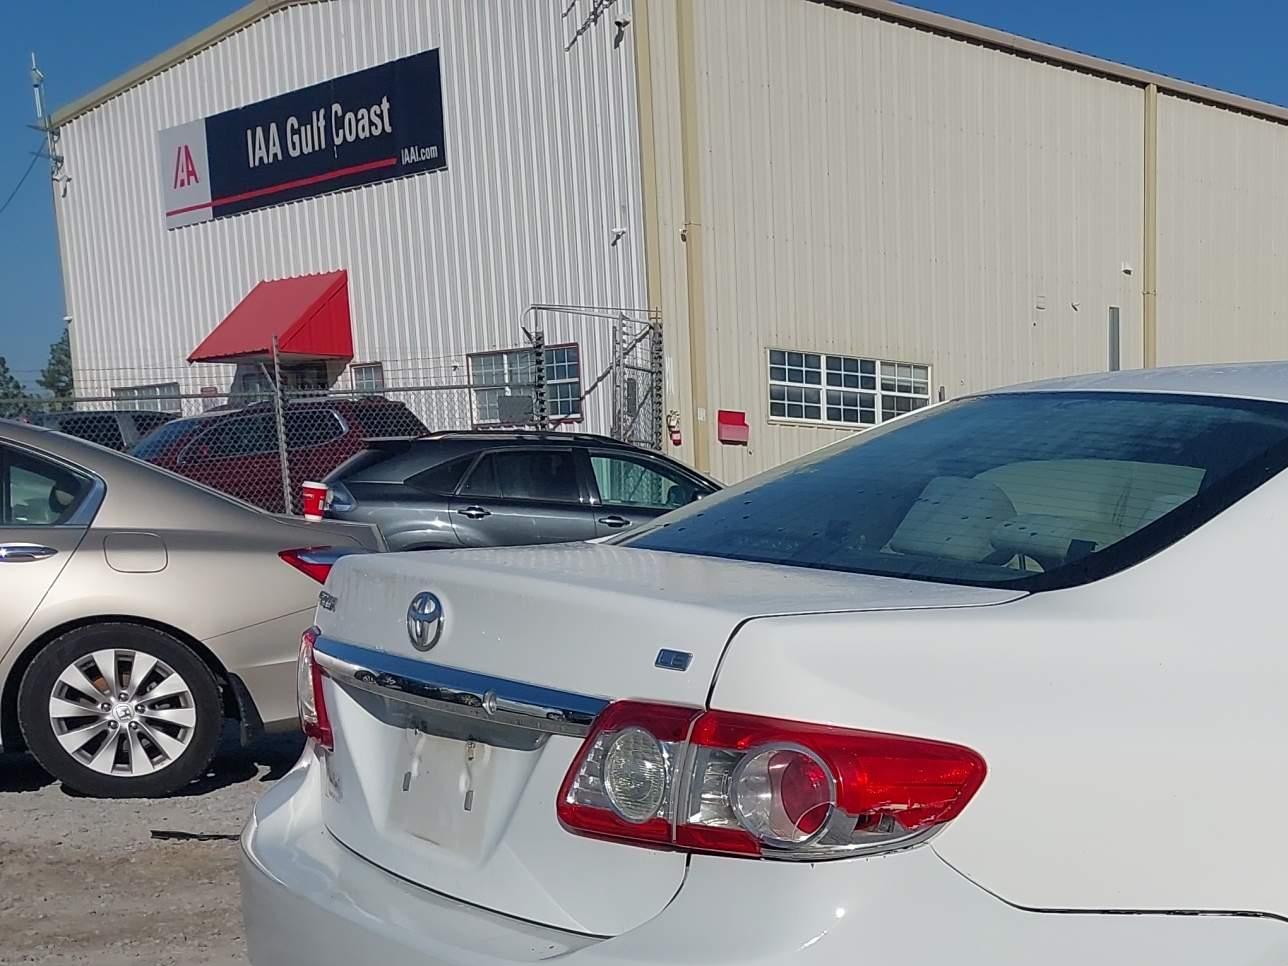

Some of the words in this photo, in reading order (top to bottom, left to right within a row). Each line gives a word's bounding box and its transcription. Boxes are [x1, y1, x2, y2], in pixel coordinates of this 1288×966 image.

[247, 122, 282, 168] IAA
[286, 108, 326, 157] Gulf
[331, 95, 392, 145] Coast
